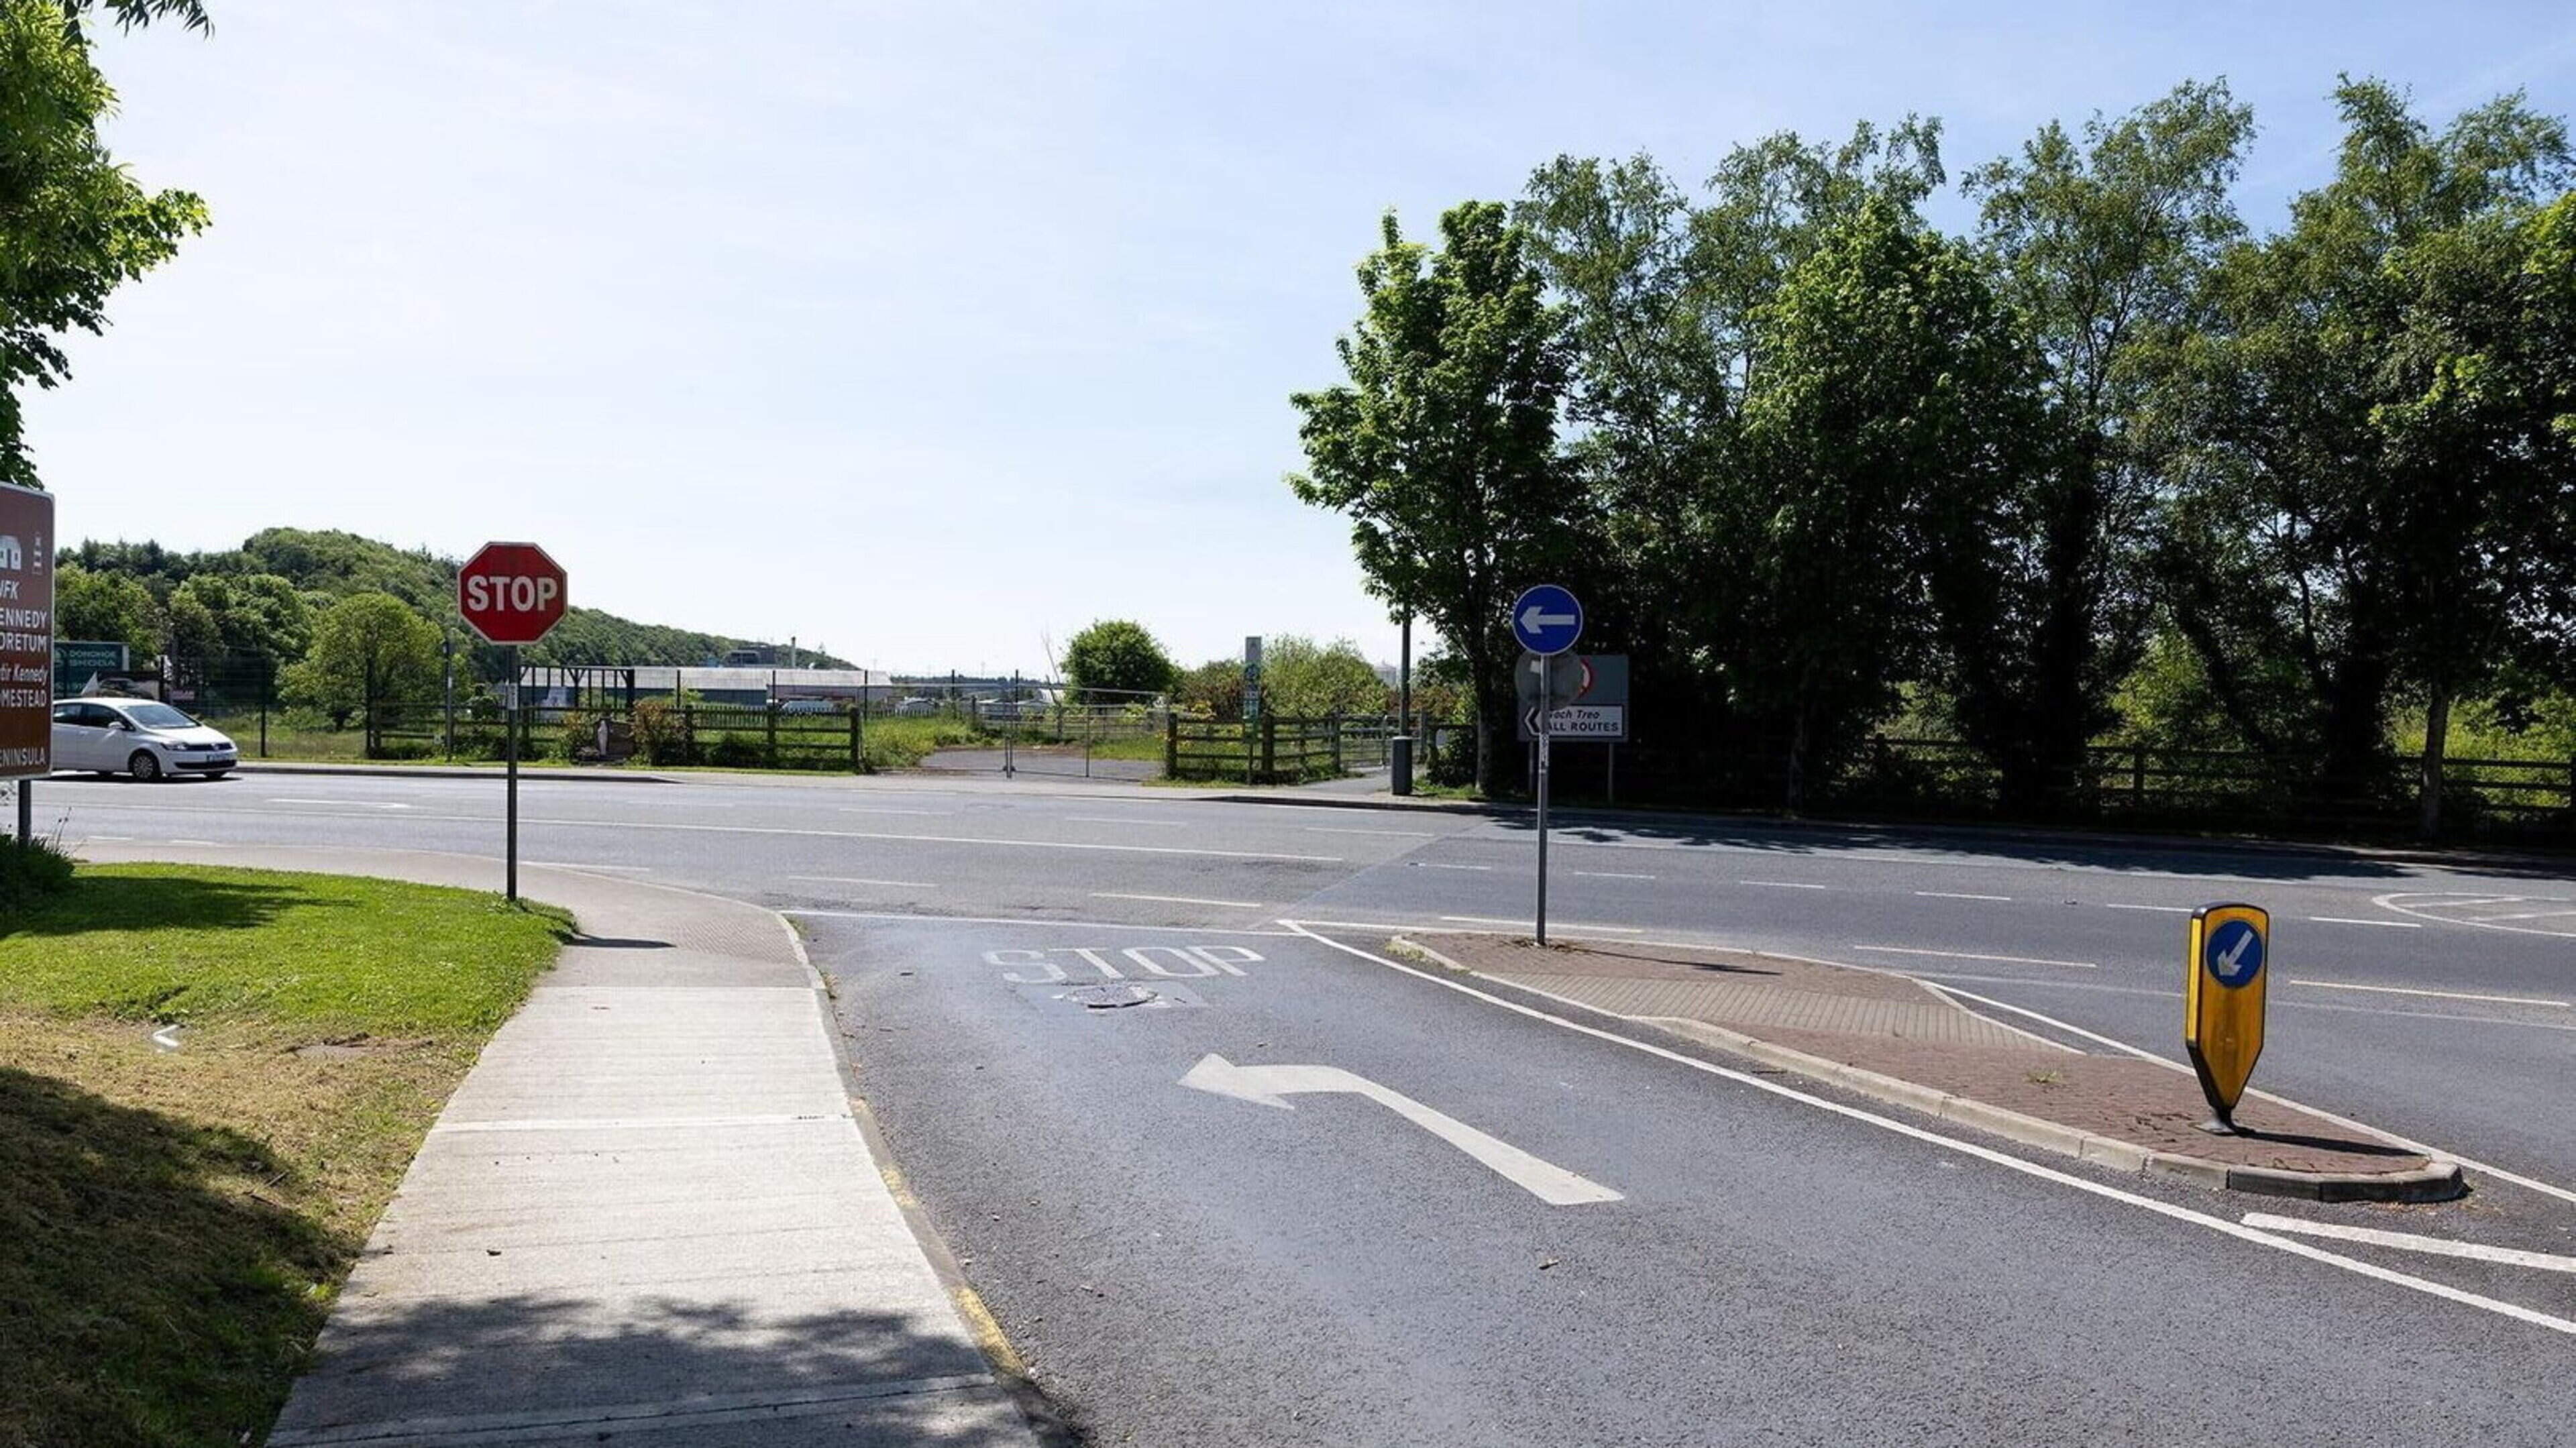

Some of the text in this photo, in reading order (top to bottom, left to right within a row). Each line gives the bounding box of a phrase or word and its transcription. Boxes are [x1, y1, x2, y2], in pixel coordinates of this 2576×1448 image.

[0, 579, 19, 600] JFK
[467, 575, 557, 612] STOP
[0, 689, 46, 708] MESTEAD
[1576, 709, 1601, 720] Treo
[1570, 722, 1619, 732] ROUTES
[981, 945, 1266, 985] STOP
